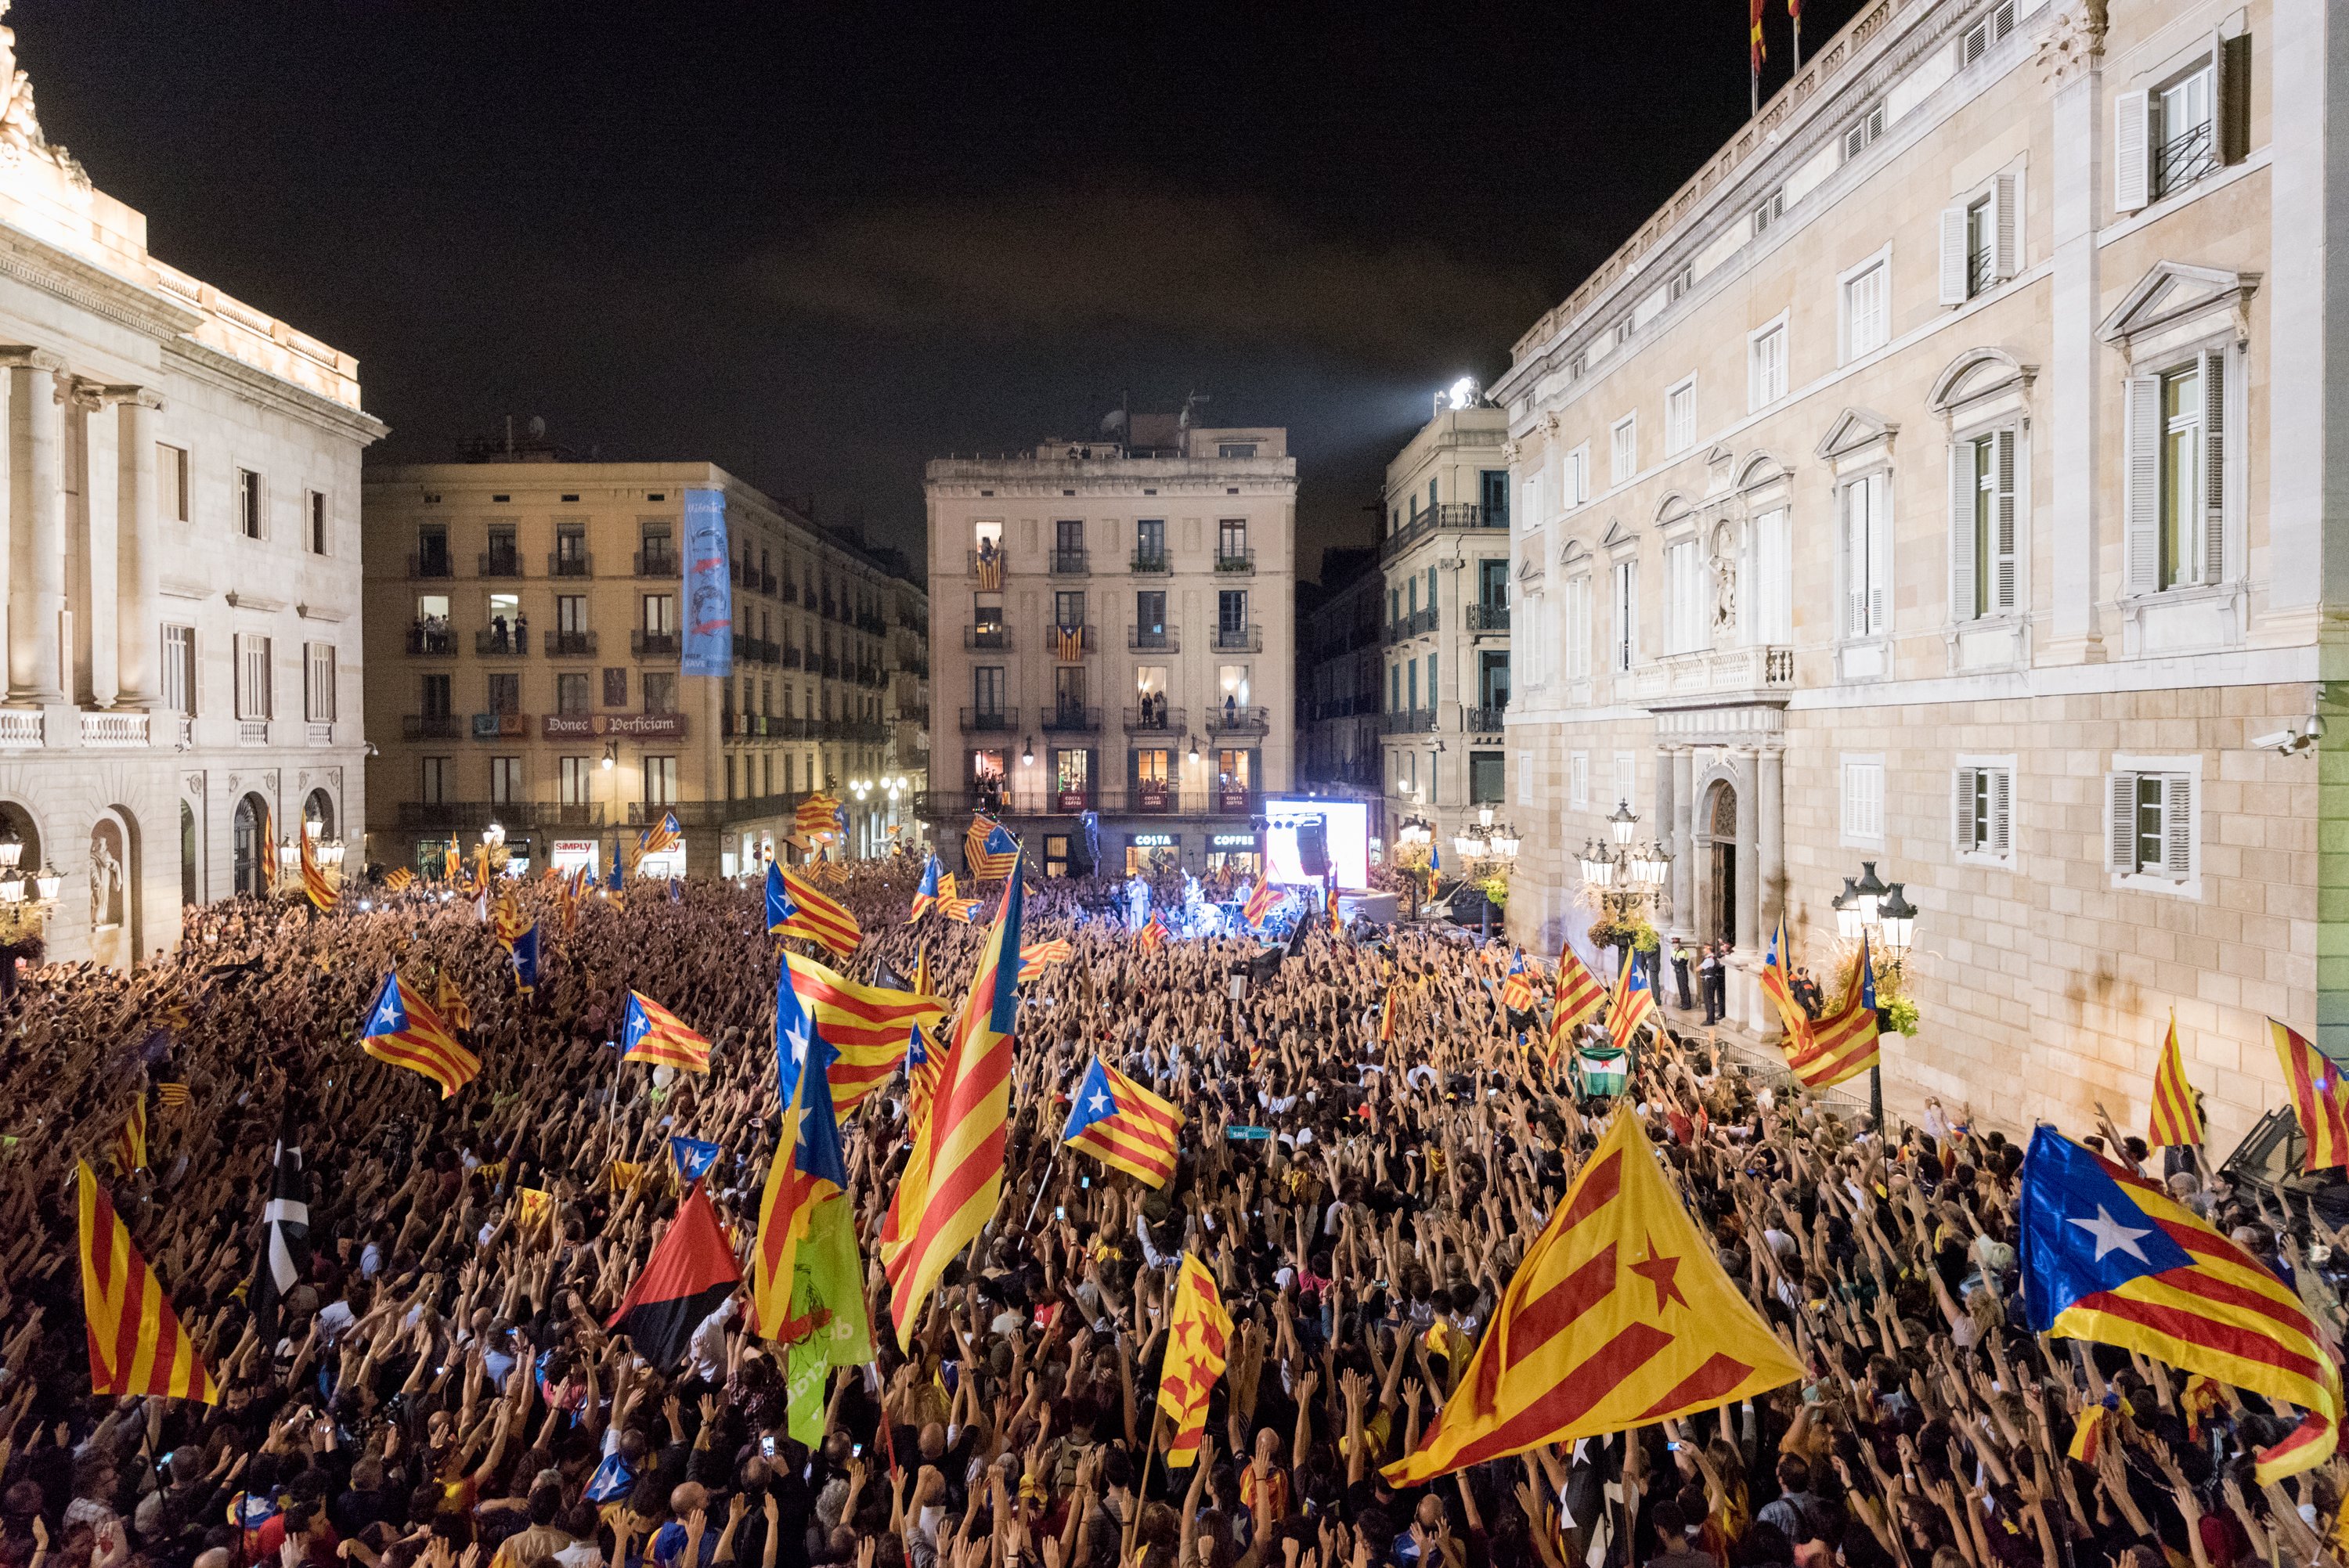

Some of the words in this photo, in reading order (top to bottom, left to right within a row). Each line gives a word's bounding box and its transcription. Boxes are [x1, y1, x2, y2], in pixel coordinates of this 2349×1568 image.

[548, 717, 588, 731] Donec
[610, 716, 674, 733] Perficiam
[1135, 835, 1171, 845] COSTA
[1214, 835, 1254, 845] COFFEE
